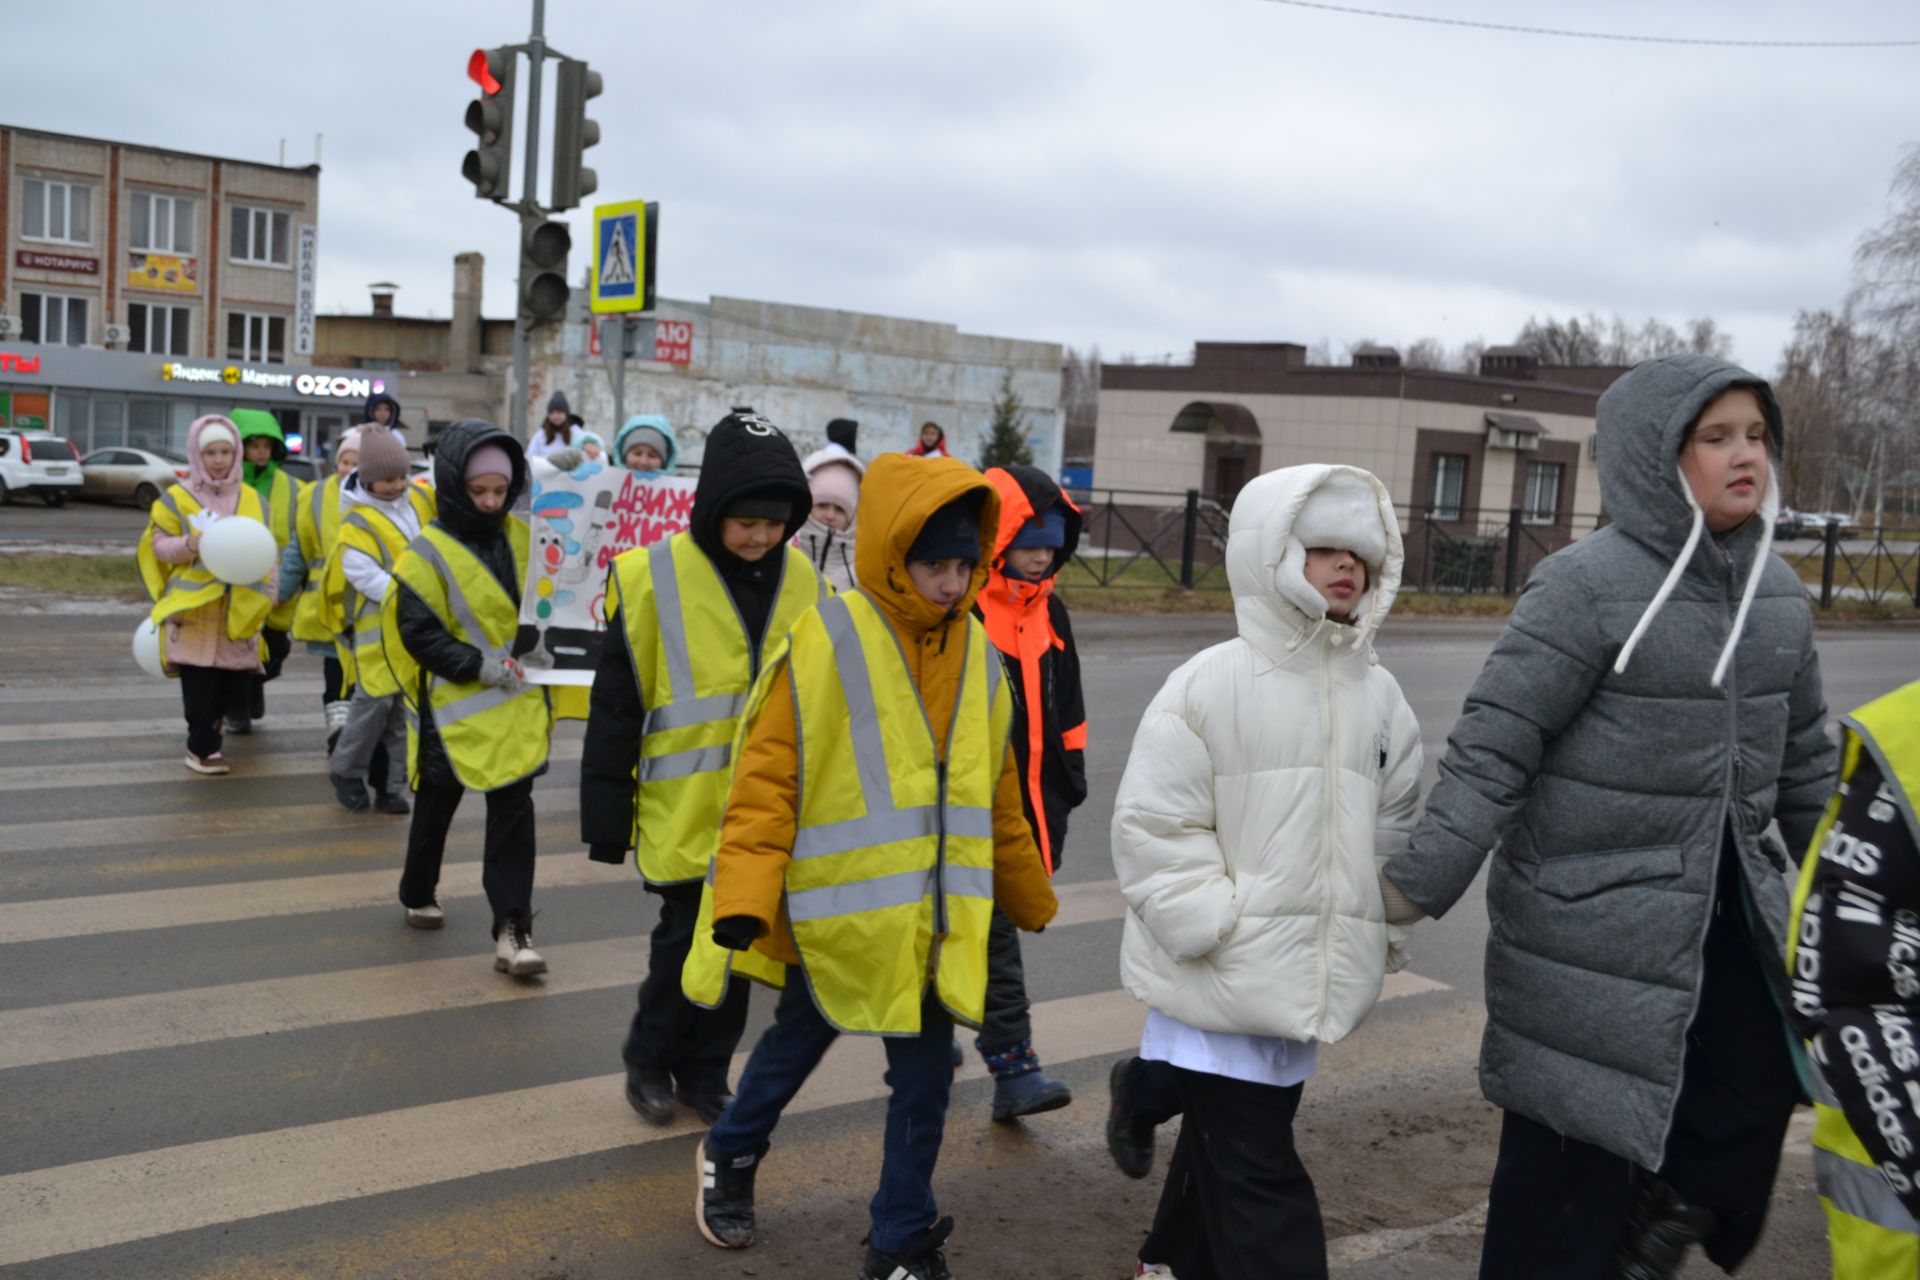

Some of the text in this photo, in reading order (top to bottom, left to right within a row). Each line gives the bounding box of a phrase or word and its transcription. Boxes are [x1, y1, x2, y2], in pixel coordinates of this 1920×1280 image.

[35, 256, 94, 271] НОТАРИУС
[300, 228, 316, 336] ЖИВАЯ ВОДА
[656, 322, 689, 345] АЮ
[0, 353, 40, 374] ТЫ
[172, 363, 293, 388] Яндекс Маркет
[295, 374, 370, 397] OZON
[612, 472, 698, 520] ДВИЖ
[1839, 1024, 1914, 1160] adidas
